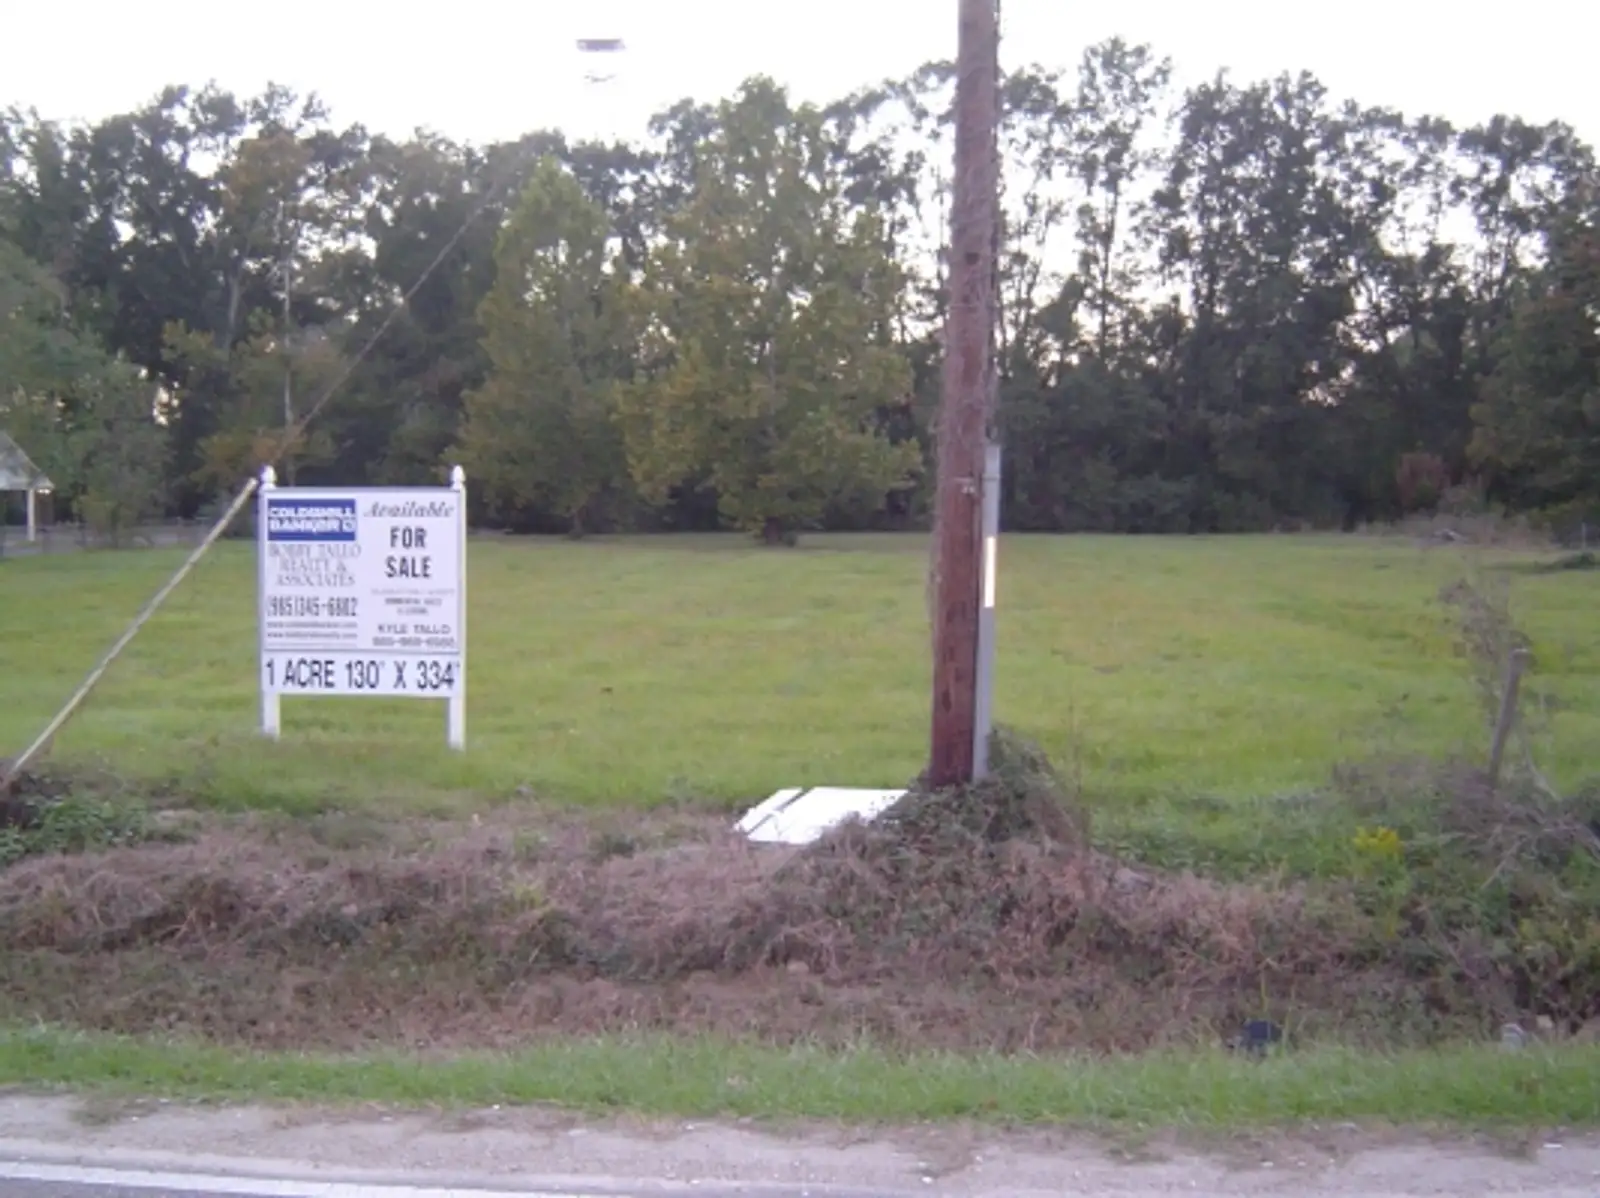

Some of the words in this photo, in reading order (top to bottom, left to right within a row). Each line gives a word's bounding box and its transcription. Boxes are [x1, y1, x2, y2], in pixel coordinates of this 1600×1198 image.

[364, 501, 454, 518] Available
[390, 526, 427, 549] FOR
[385, 555, 432, 579] SALE
[276, 573, 355, 586] ASSOCIATES
[378, 624, 408, 634] KYLE
[413, 624, 451, 634] TALLO
[265, 658, 275, 686] 1
[283, 658, 335, 688] ACRE
[393, 661, 407, 689] X
